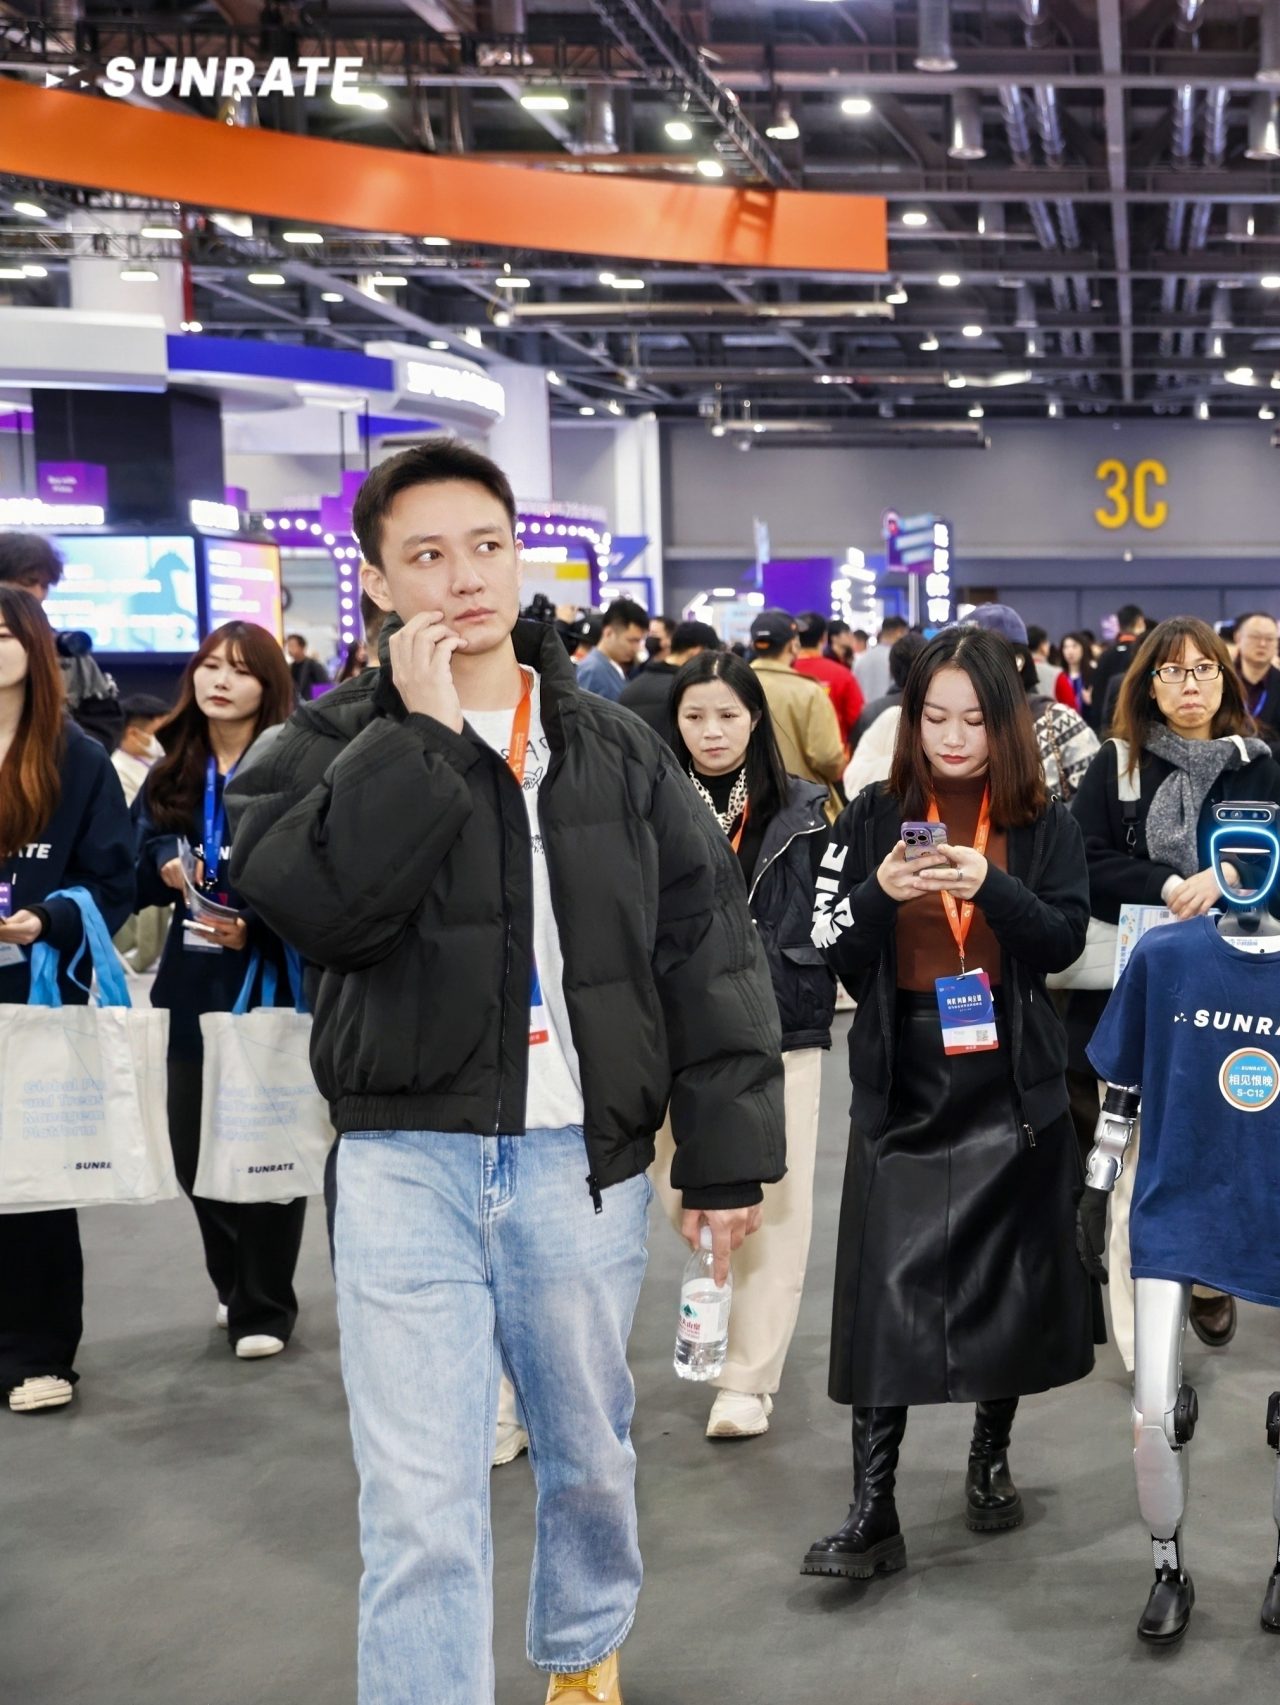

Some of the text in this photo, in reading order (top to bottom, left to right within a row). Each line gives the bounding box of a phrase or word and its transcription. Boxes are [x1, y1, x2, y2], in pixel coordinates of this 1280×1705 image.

[1095, 458, 1168, 529] 3C
[1228, 1073, 1273, 1087] 相见恨晚
[1236, 1088, 1264, 1098] S-C12
[247, 1163, 294, 1174] SUNRATE
